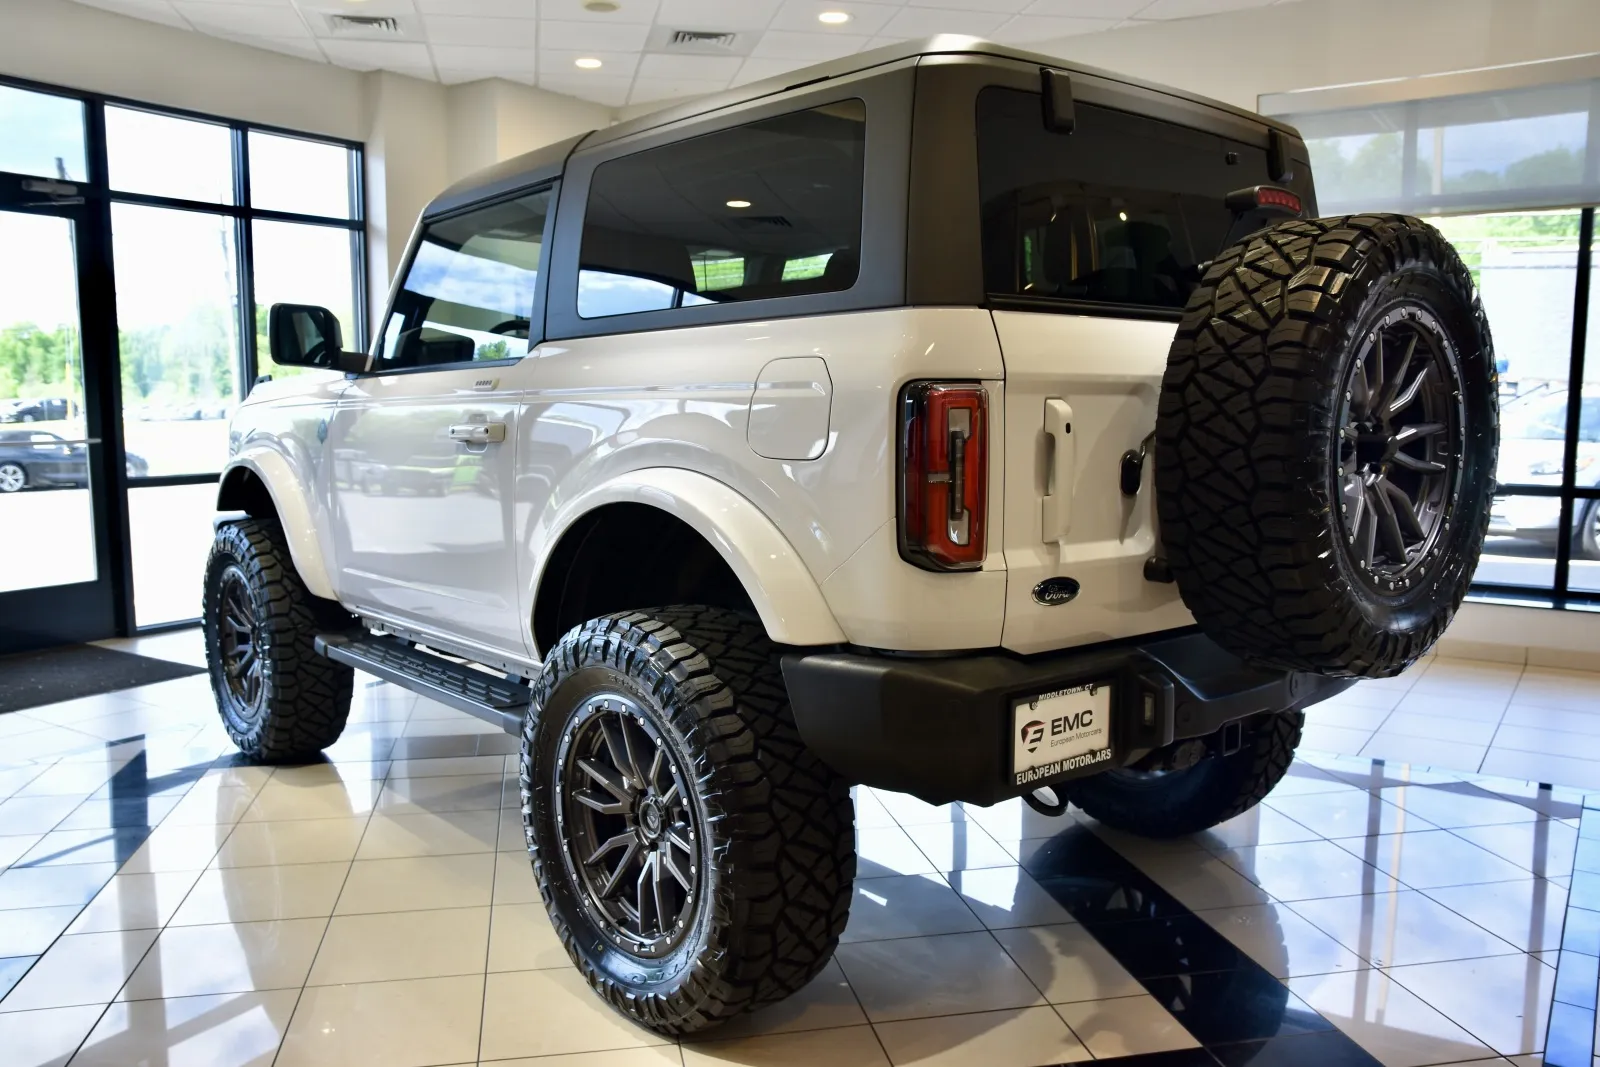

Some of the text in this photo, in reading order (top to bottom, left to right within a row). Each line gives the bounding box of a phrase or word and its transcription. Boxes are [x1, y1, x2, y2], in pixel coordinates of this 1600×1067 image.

[1084, 683, 1094, 691] CT
[1051, 709, 1093, 736] EMC
[1050, 727, 1102, 748] European Motorcars
[1016, 748, 1111, 785] EUROPEAN MOTORCARS
